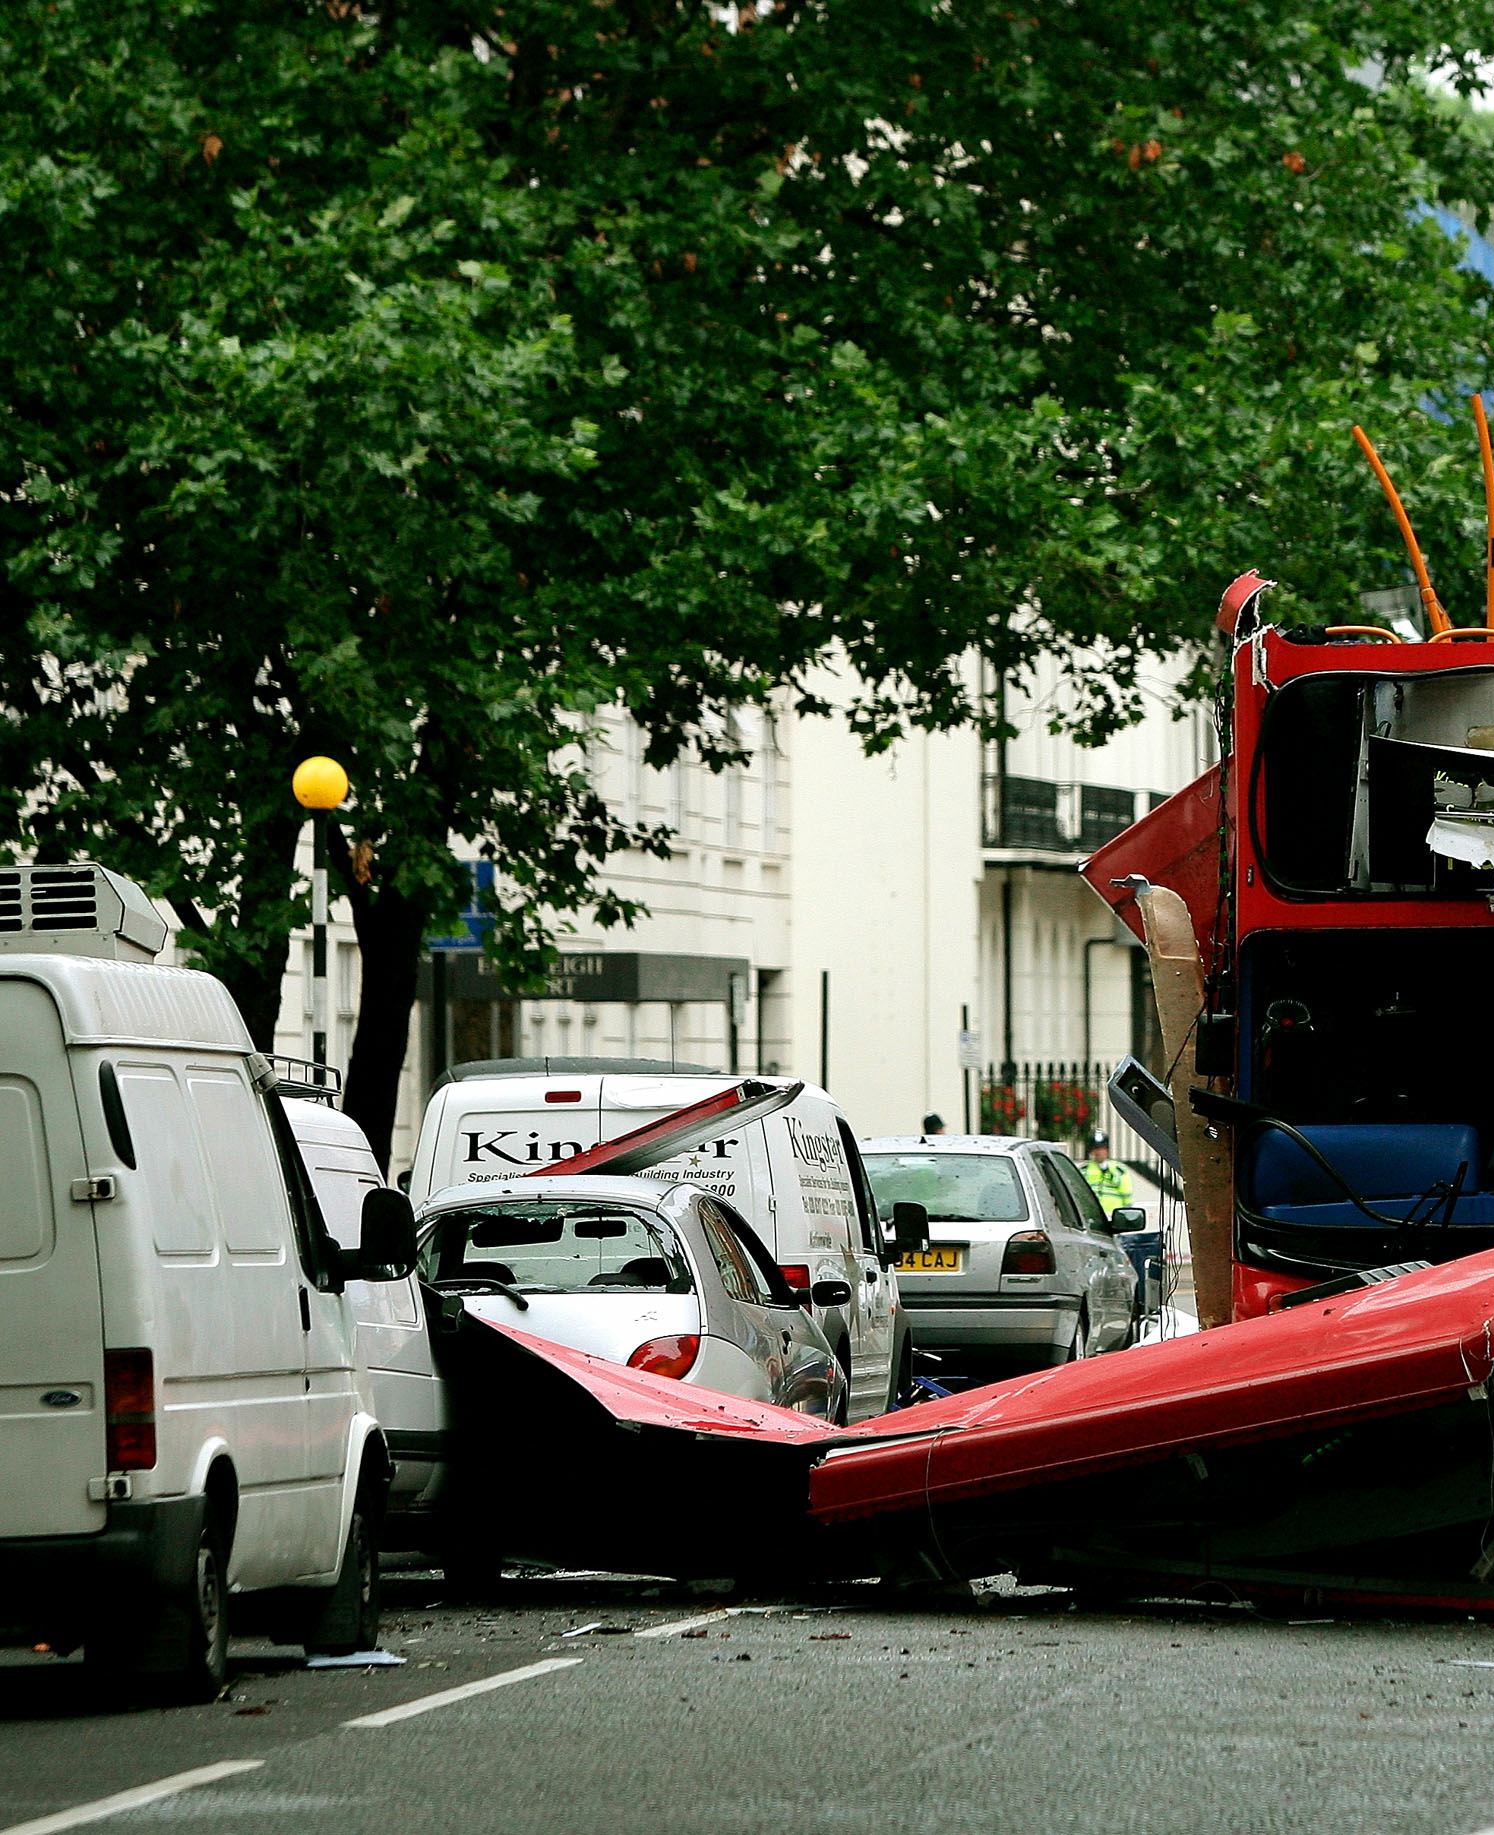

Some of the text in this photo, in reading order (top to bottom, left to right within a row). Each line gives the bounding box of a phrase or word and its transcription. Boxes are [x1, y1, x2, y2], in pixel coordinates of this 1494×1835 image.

[782, 1116, 844, 1173] Kingstar
[630, 1170, 680, 1181] uilding
[683, 1169, 735, 1181] Industry
[921, 1250, 957, 1268] CAJ
